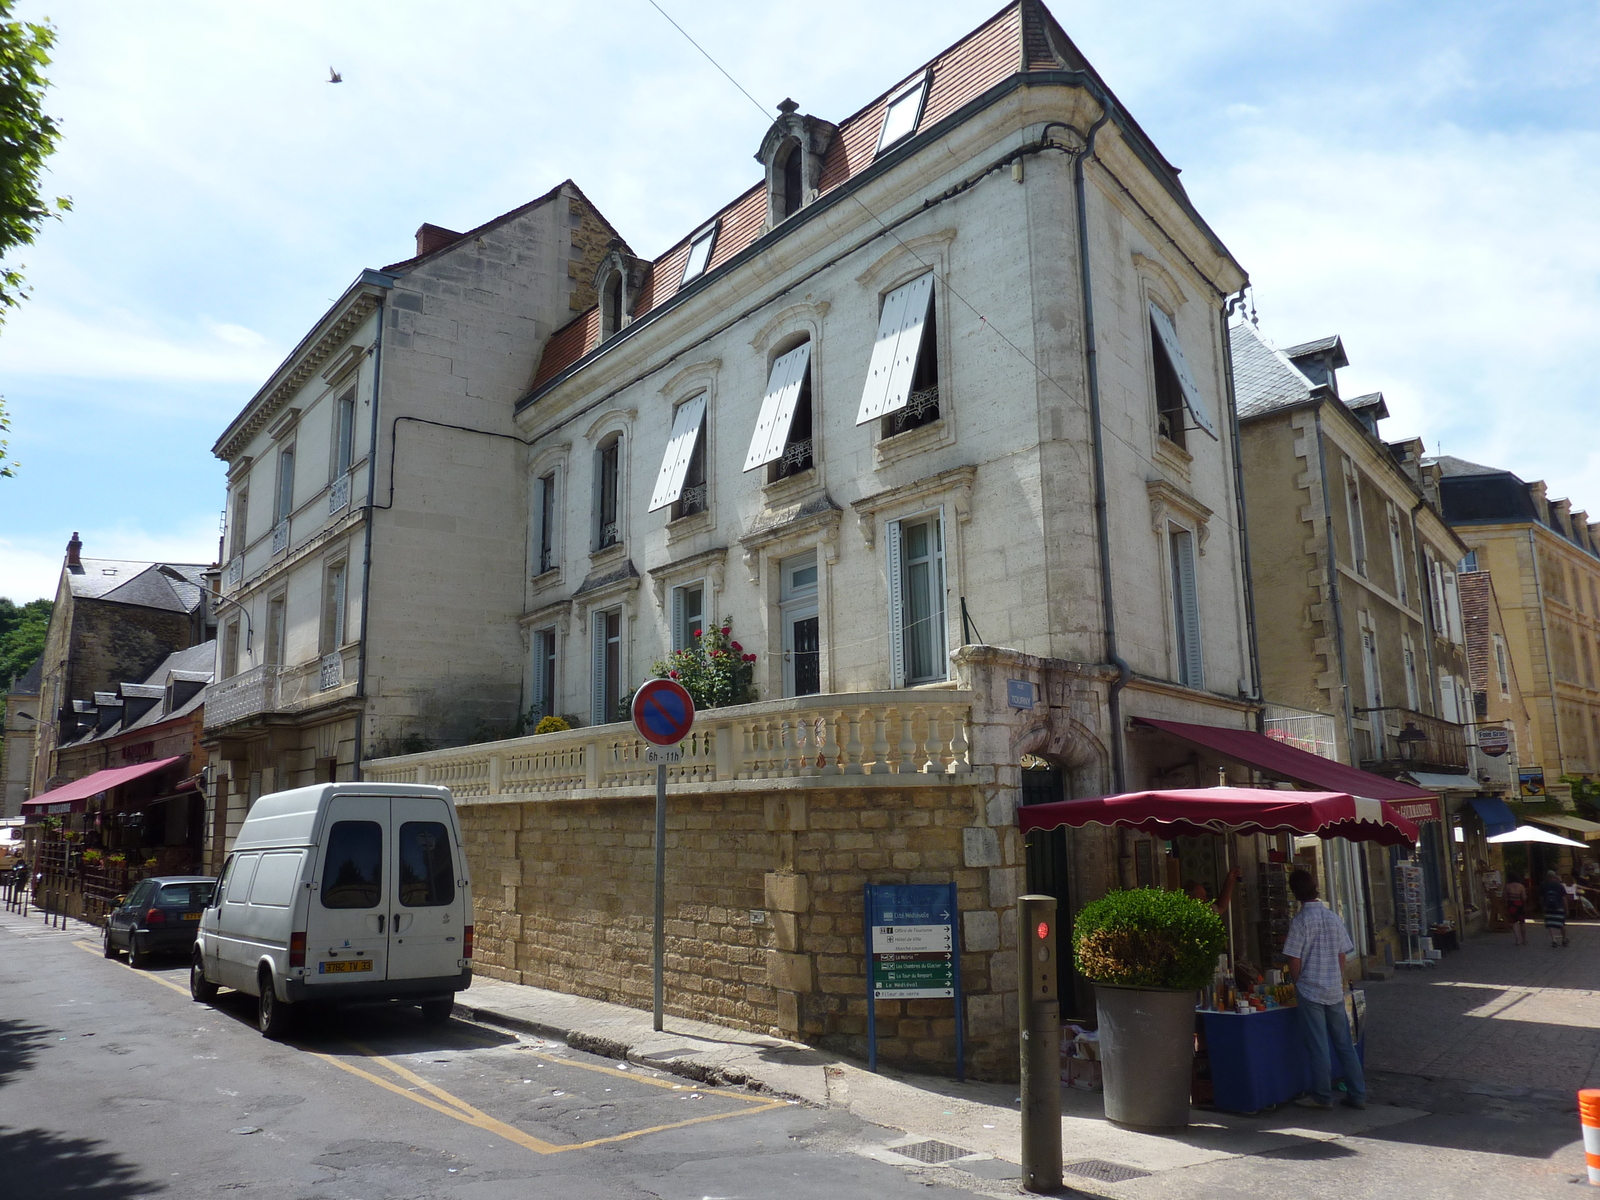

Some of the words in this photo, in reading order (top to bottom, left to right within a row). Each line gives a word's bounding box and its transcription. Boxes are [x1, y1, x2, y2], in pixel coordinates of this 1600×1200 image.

[649, 752, 658, 761] 6h
[666, 752, 679, 761] 11h
[349, 962, 358, 970] TV
[361, 961, 371, 970] 33
